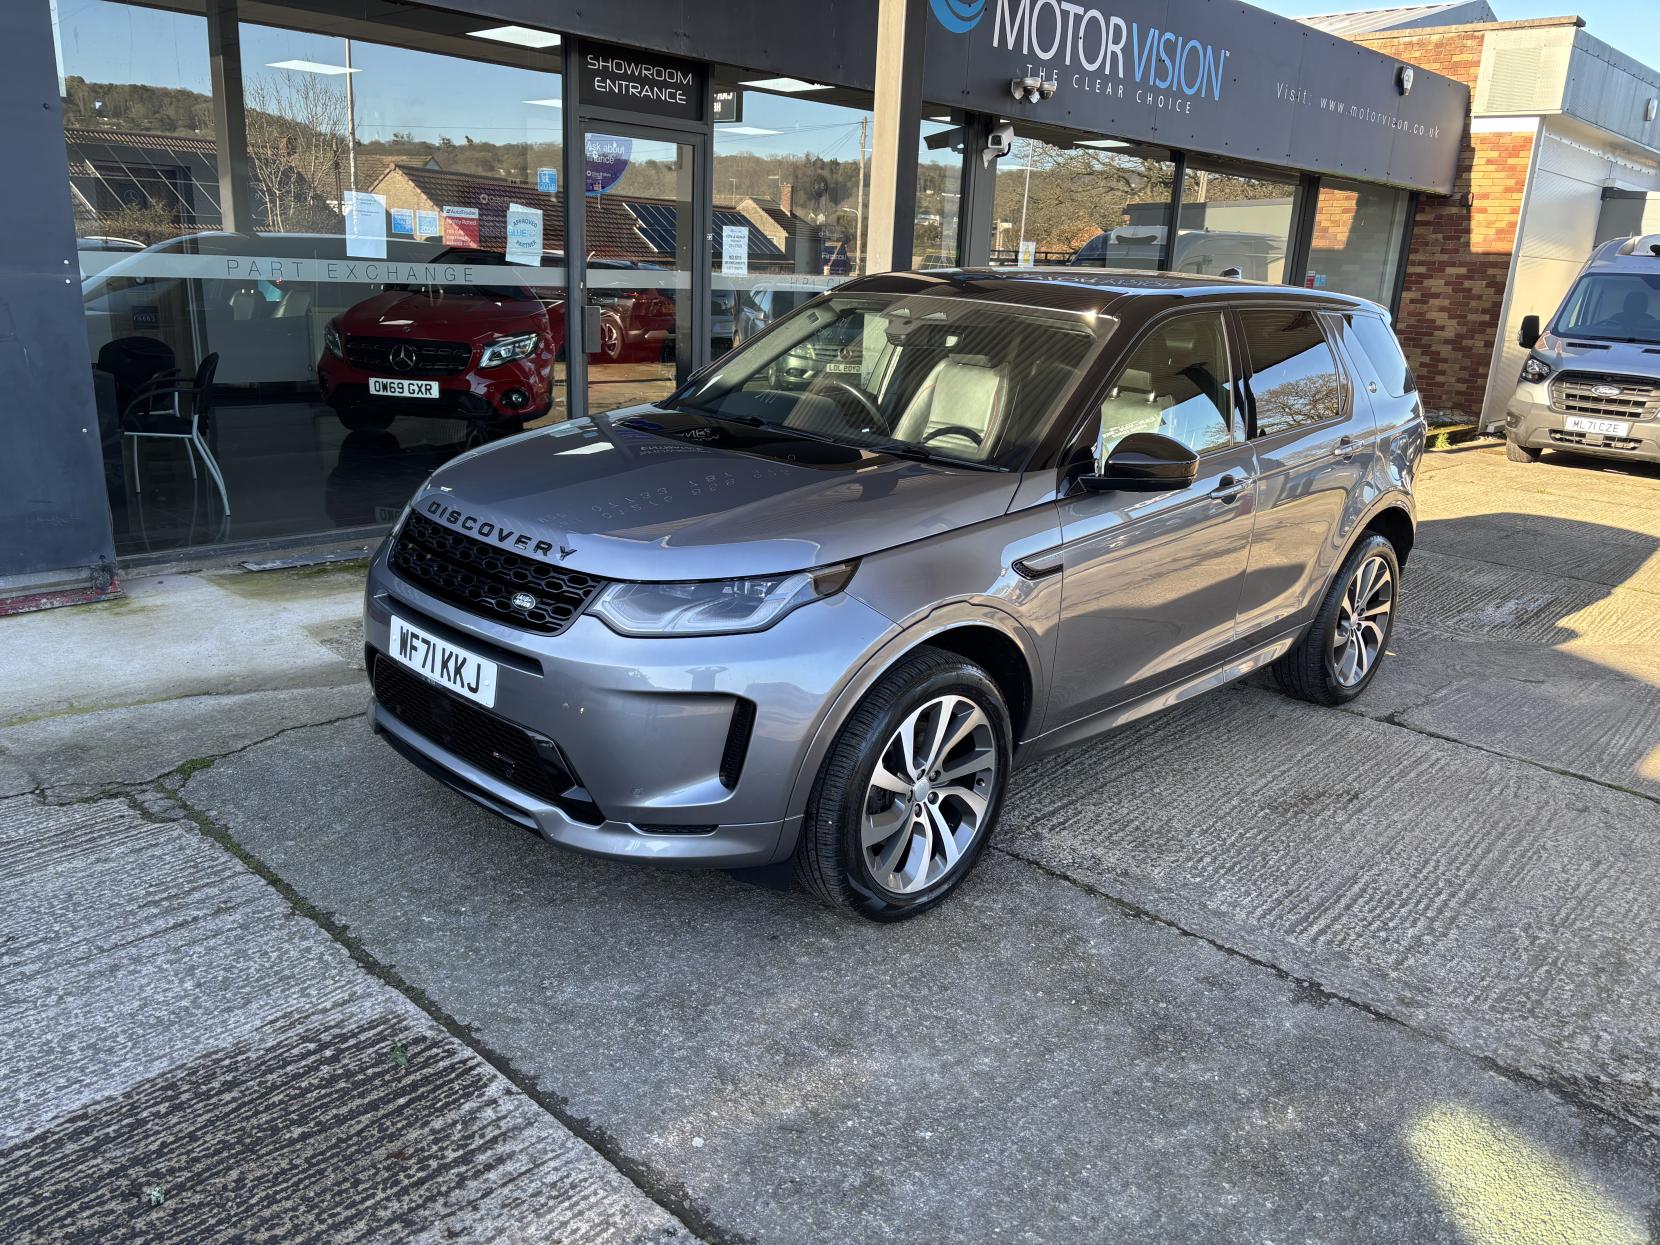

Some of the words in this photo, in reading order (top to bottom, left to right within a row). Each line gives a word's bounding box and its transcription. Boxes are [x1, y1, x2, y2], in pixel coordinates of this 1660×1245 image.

[586, 54, 693, 87] SHOWROOM
[594, 77, 687, 104] ENTRANCE
[1026, 64, 1059, 84] THE
[1072, 74, 1124, 99] CLEAR
[1136, 90, 1192, 114] CHOICE
[1276, 82, 1313, 106] Visit:
[586, 141, 601, 152] Ask
[603, 142, 625, 154] about
[512, 218, 538, 228] APPROVED
[515, 239, 537, 248] PARTNER
[227, 259, 304, 279] PART
[327, 262, 474, 283] EXCHANGE
[374, 380, 405, 394] OW69
[407, 382, 433, 396] GXR
[1573, 419, 1597, 431] ML71
[1598, 422, 1620, 433] CZE
[427, 500, 578, 562] DISCOVERY
[400, 625, 437, 674] WF71
[440, 647, 482, 694] KKJ
